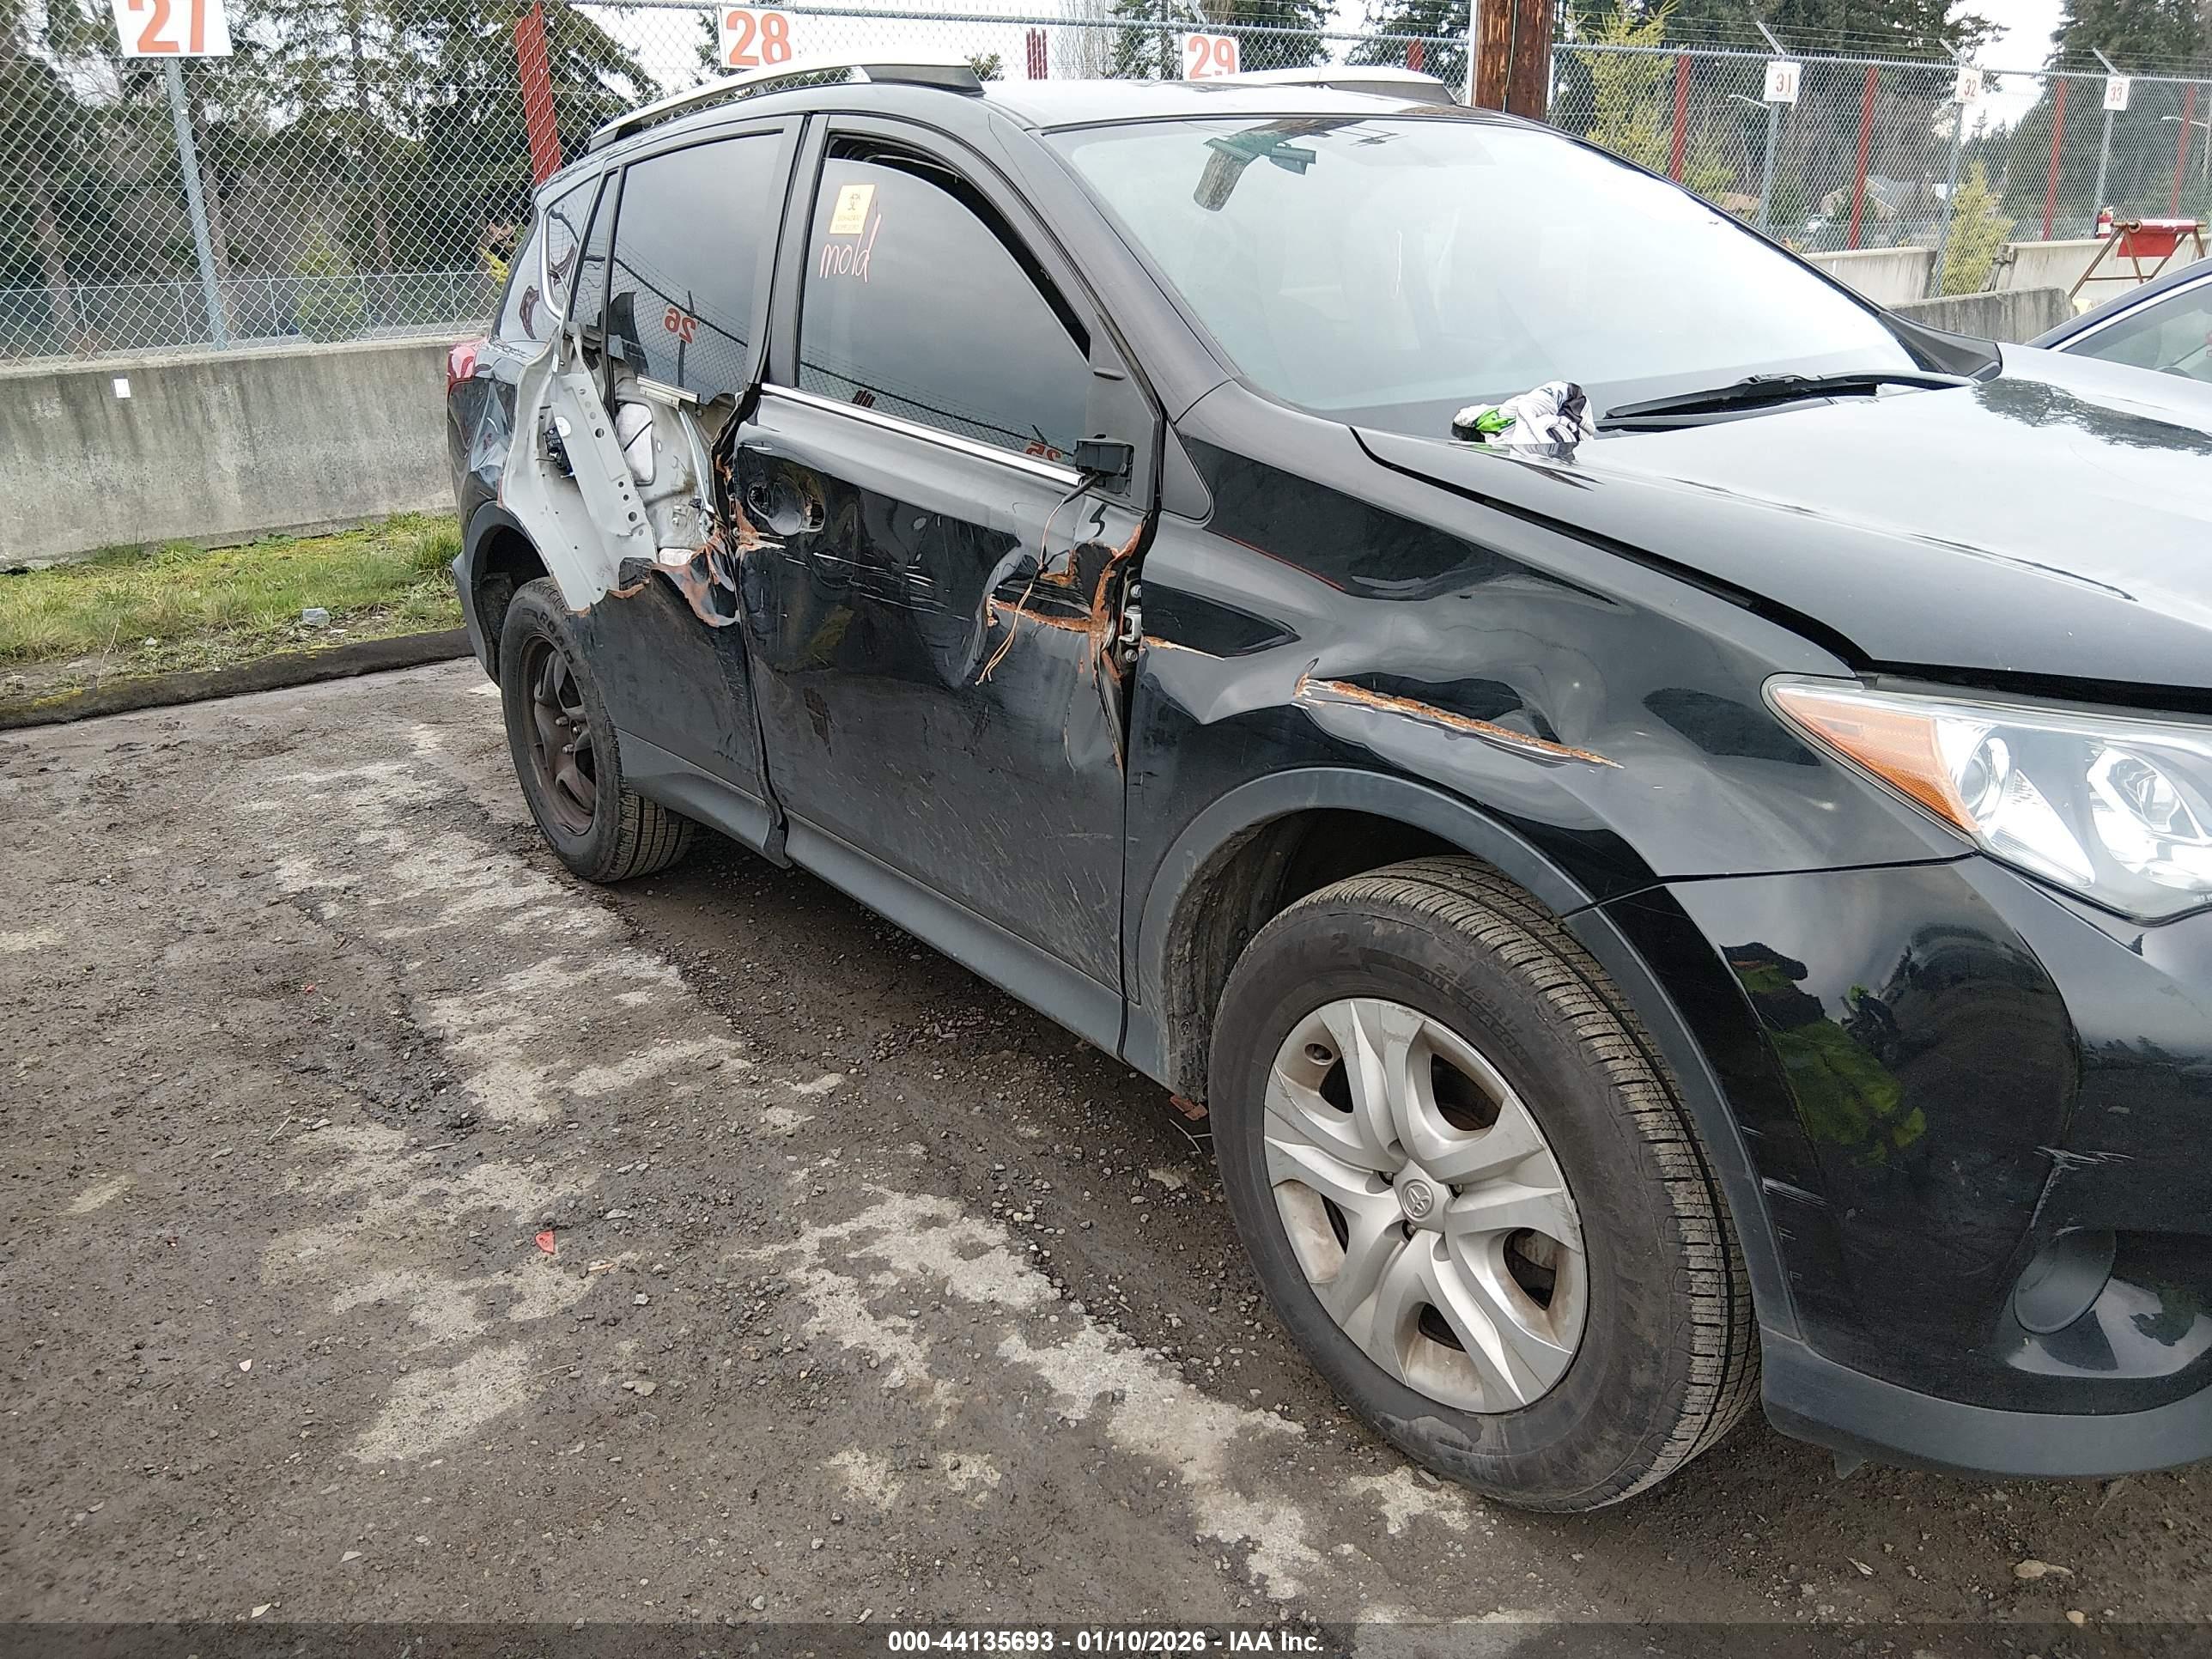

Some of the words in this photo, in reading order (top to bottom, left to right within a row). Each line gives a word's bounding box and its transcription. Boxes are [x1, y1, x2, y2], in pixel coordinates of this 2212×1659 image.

[726, 10, 792, 66] 28
[1188, 35, 1236, 79] 29
[1776, 72, 1791, 94] 31
[1964, 78, 1977, 97] 32
[2110, 86, 2123, 102] 33
[819, 213, 882, 283] mold
[1419, 969, 1451, 996] ALL
